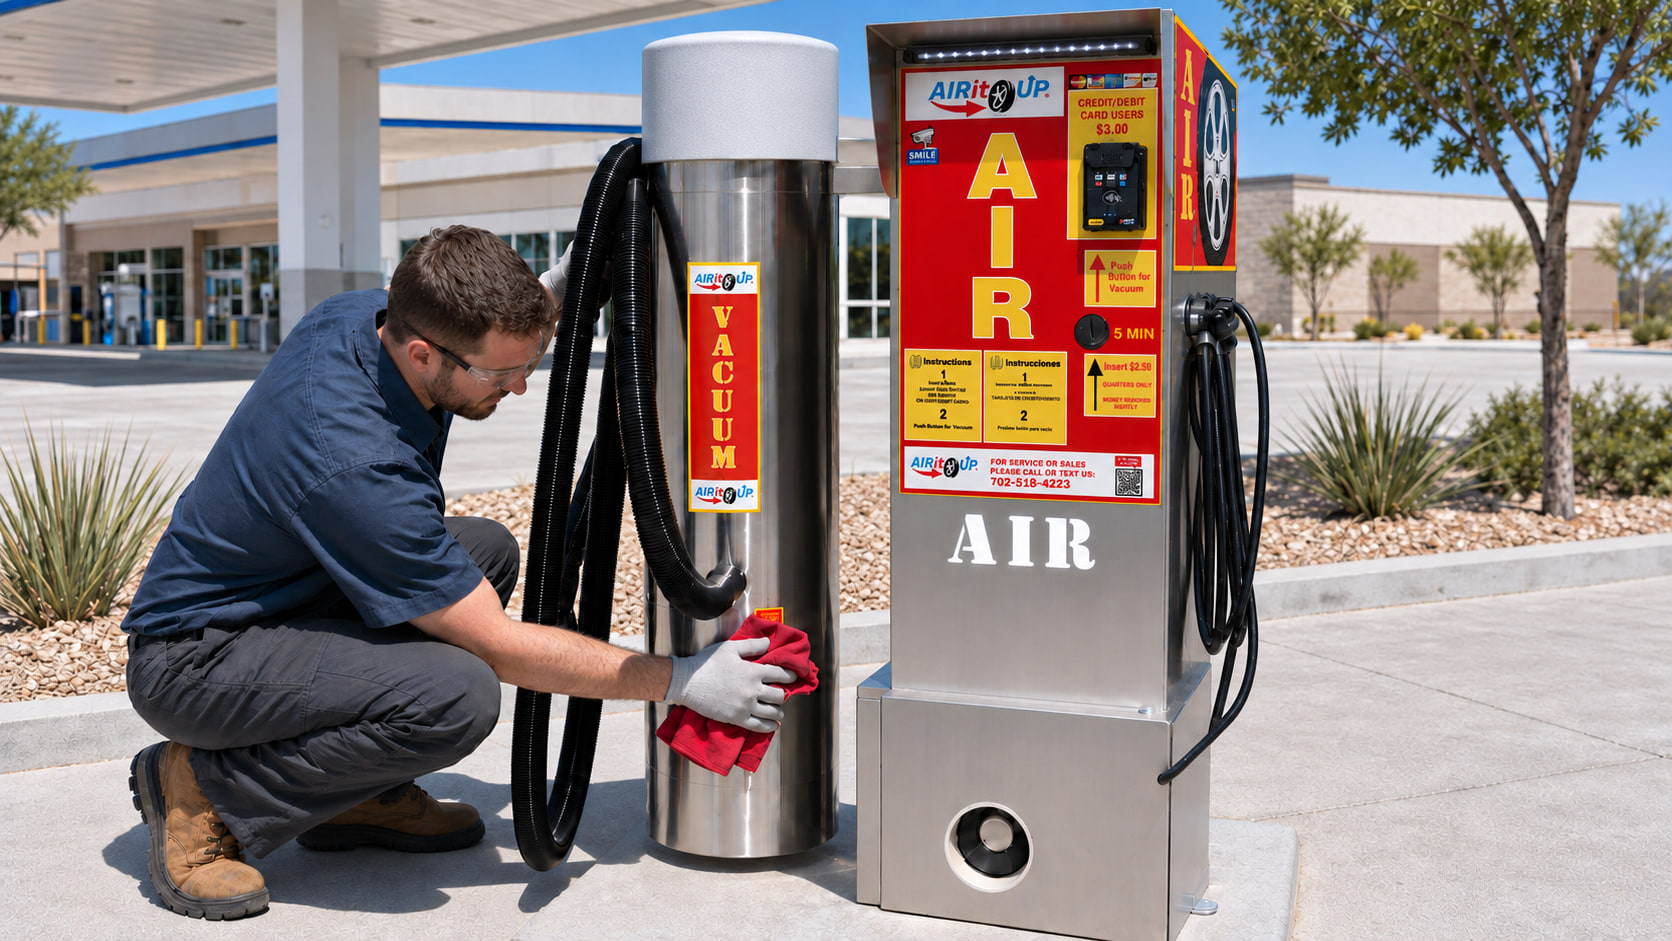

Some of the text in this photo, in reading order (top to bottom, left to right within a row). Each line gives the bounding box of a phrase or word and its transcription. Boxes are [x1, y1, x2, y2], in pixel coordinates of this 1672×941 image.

[1078, 97, 1145, 107] CREDIT/DEBIT
[1080, 110, 1144, 120] CARD USERS
[1096, 123, 1129, 136] $3.00
[1180, 48, 1195, 221] AIR
[909, 151, 936, 160] SMILE
[967, 132, 1038, 340] AIR
[1110, 261, 1133, 271] Push
[1138, 272, 1151, 281] for
[1109, 284, 1144, 293] Vacuum
[1113, 327, 1155, 340] 5 MIN
[923, 357, 972, 366] Instructions
[1005, 358, 1061, 368] Instrucciones
[1103, 361, 1152, 372] Insert $2.50
[941, 369, 946, 379] 1
[1022, 372, 1027, 382] 1
[711, 306, 737, 469] VACUUM
[939, 408, 947, 420] 2
[1020, 409, 1028, 421] 2
[990, 458, 1007, 466] FOR
[1009, 459, 1044, 467] SERVICE
[1060, 460, 1086, 468] SALES
[990, 467, 1021, 475] PLEASE
[1022, 468, 1043, 476] CALL
[1044, 469, 1057, 477] OR
[990, 477, 1071, 489] 702-518-4223
[947, 513, 1096, 570] AIR
